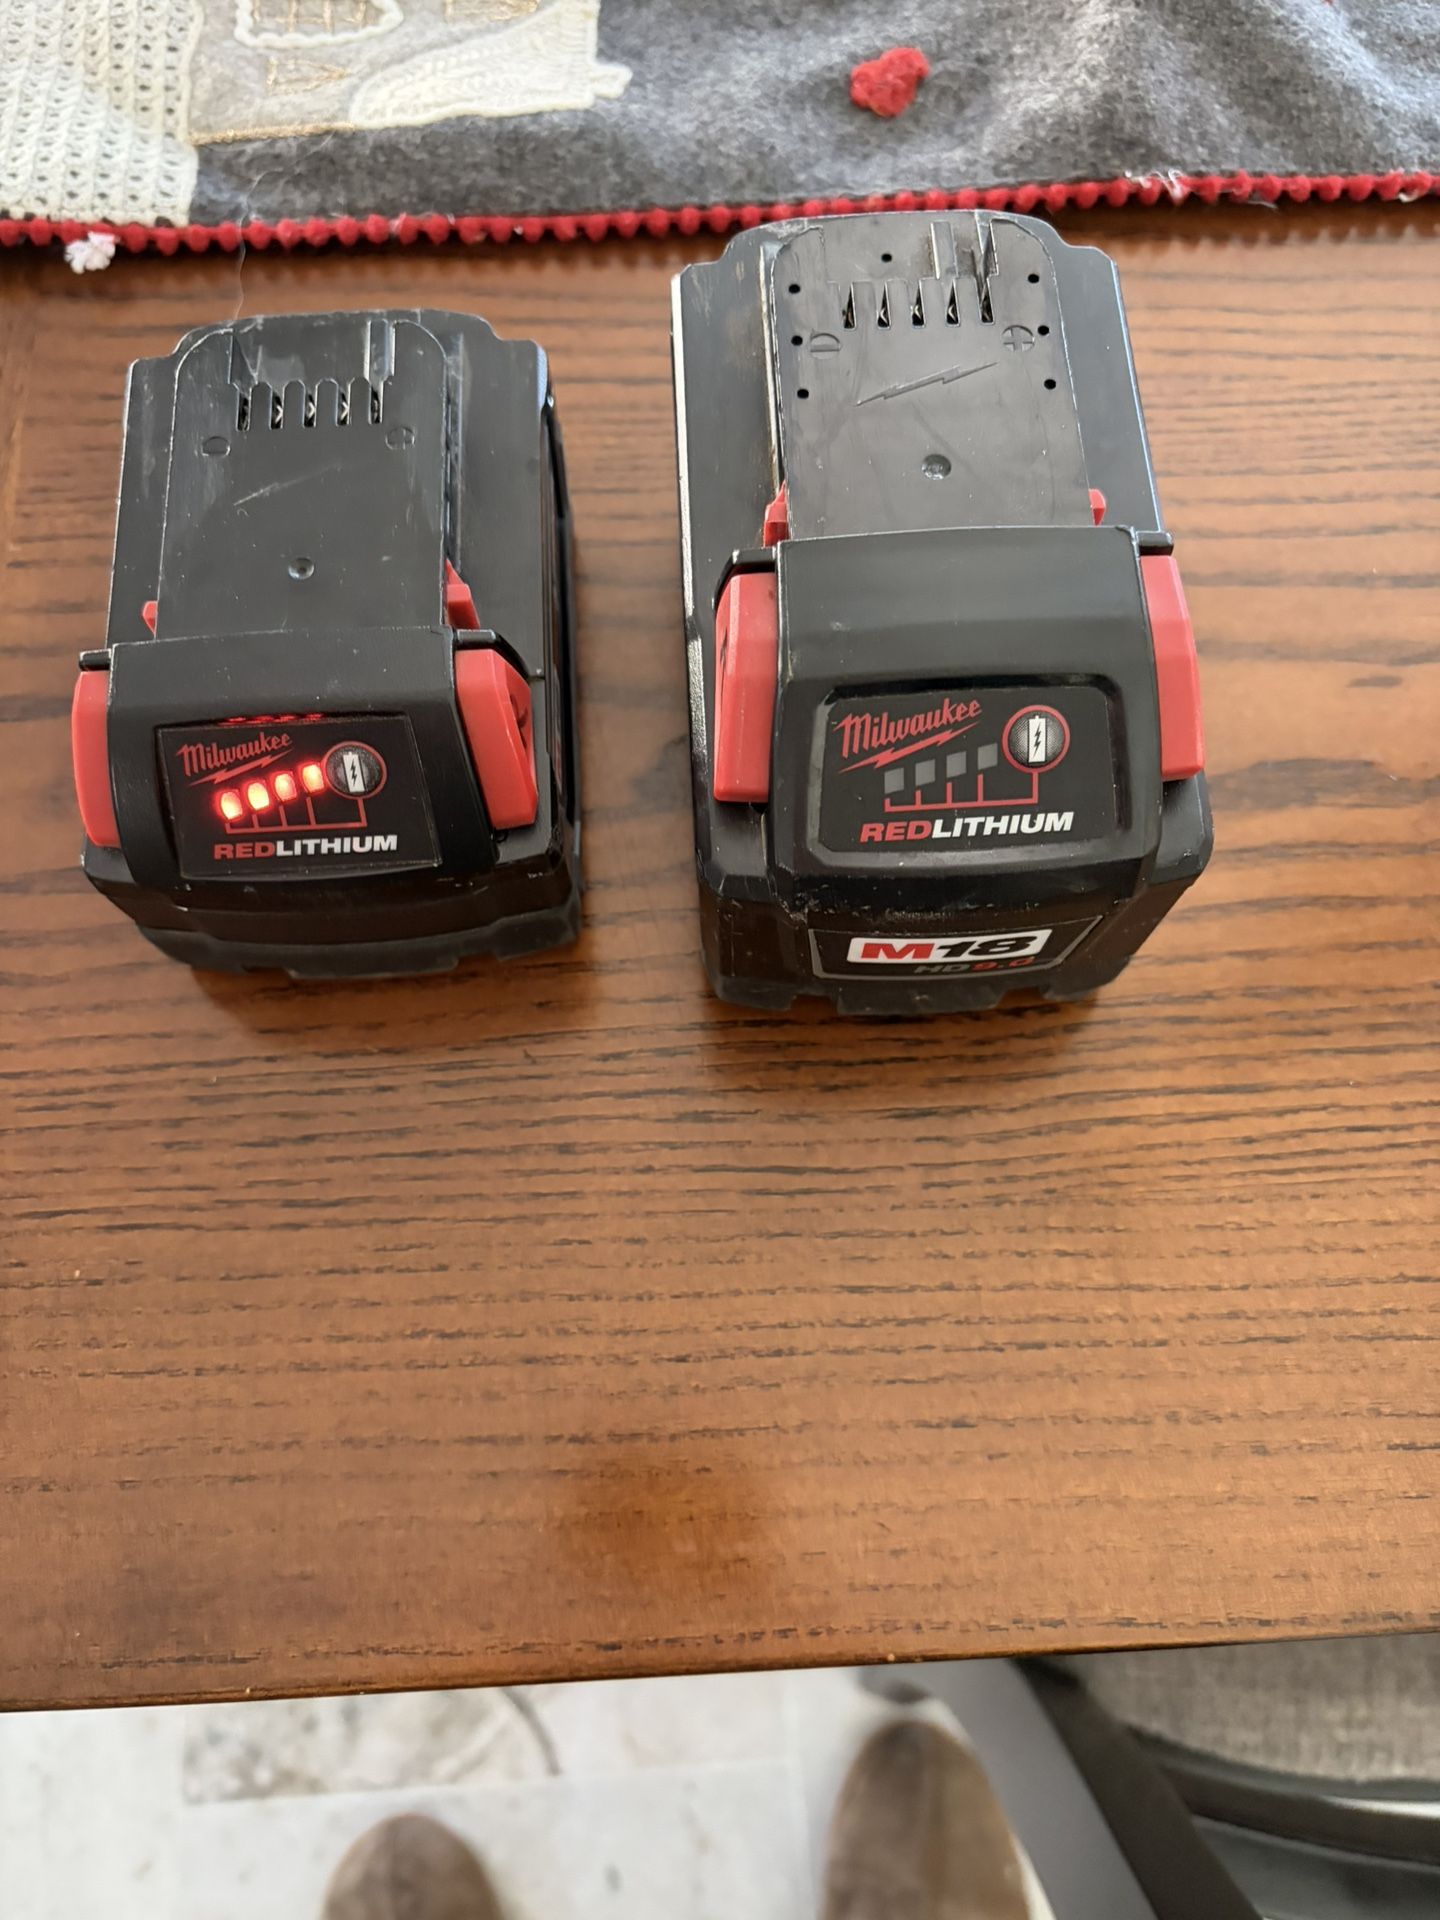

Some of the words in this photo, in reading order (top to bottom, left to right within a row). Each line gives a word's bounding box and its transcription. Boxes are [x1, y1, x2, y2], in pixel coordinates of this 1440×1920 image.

[833, 698, 982, 759] Milwaukee
[176, 731, 293, 776] Milwaukee
[859, 811, 1075, 843] REDLITHIUM
[213, 834, 398, 859] REDLITHIUM
[860, 935, 1038, 960] M18
